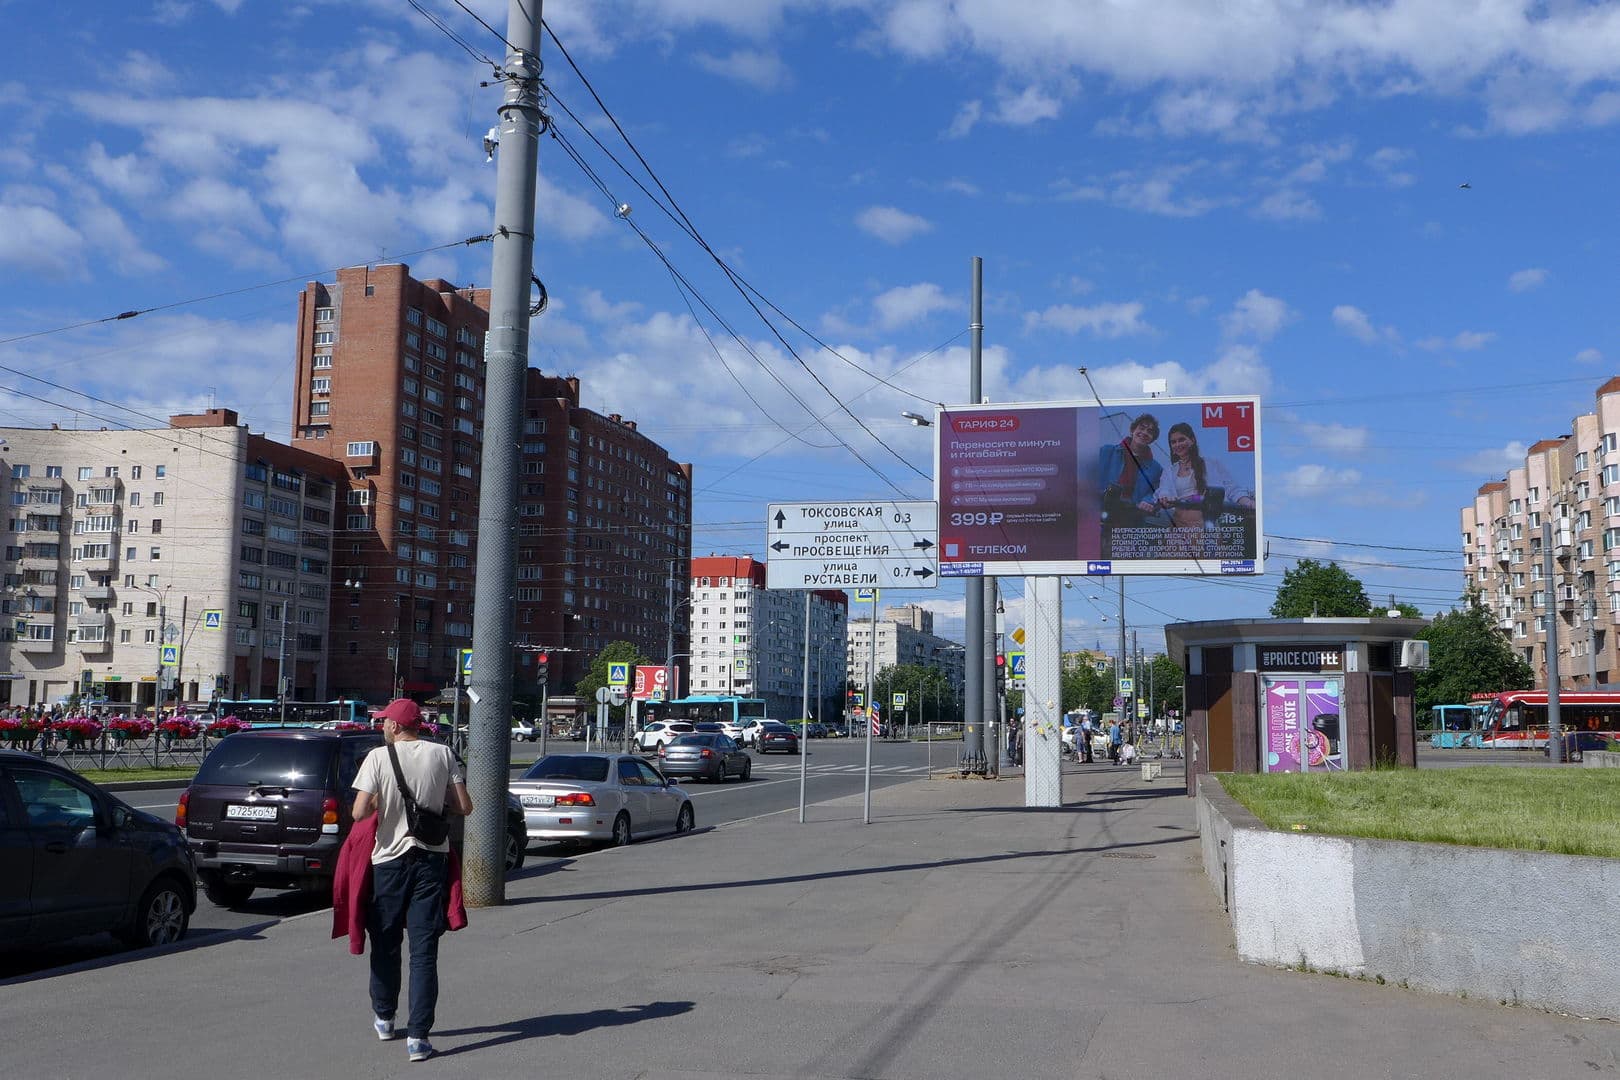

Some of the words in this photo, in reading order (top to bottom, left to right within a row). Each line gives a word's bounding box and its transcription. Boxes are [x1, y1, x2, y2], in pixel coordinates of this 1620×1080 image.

[958, 420, 998, 429] ТАРИФ
[999, 419, 1014, 428] 24
[950, 440, 1018, 450] Переносите
[1018, 439, 1060, 449] минуты
[960, 449, 1016, 458] гигабайты
[800, 506, 882, 518] ТОКСОВСКАЯ
[894, 513, 911, 524] 0.3
[824, 520, 858, 530] улица
[814, 534, 868, 545] проспект
[794, 545, 889, 557] ПРОСВЕЩЕНИЯ
[969, 545, 1027, 554] ТЕЛЕКОМ
[823, 563, 858, 573] улица
[893, 567, 911, 577] 0.7
[804, 574, 877, 584] РУСТАВЕЛИ
[1270, 651, 1300, 666] PRICE
[1302, 651, 1339, 666] COFFEE
[1272, 705, 1284, 730] LOVE
[1284, 700, 1296, 730] TASTE
